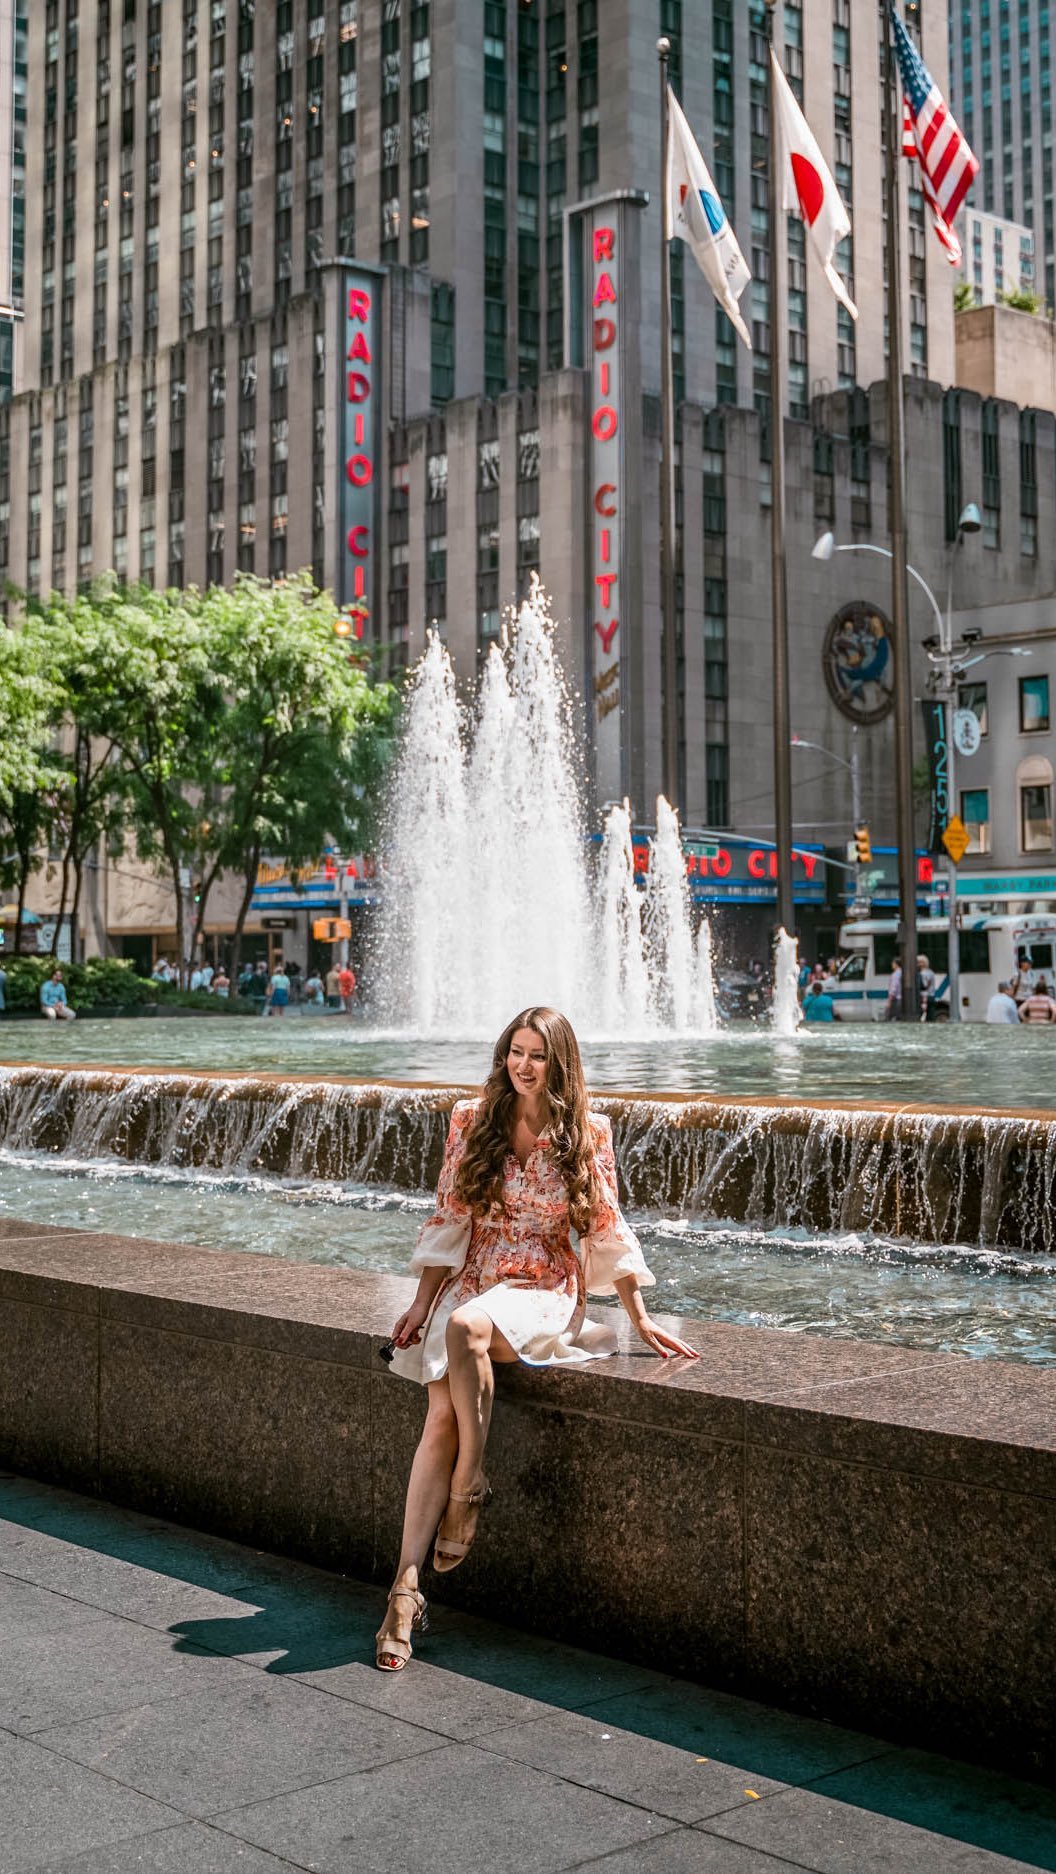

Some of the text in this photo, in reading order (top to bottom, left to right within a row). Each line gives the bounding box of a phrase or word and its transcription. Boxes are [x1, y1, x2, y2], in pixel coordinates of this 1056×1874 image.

[592, 227, 617, 442] RADIO
[346, 288, 373, 642] RADIO CIT
[594, 484, 619, 654] CITY
[632, 847, 732, 877] RIO
[748, 850, 817, 879] CIY
